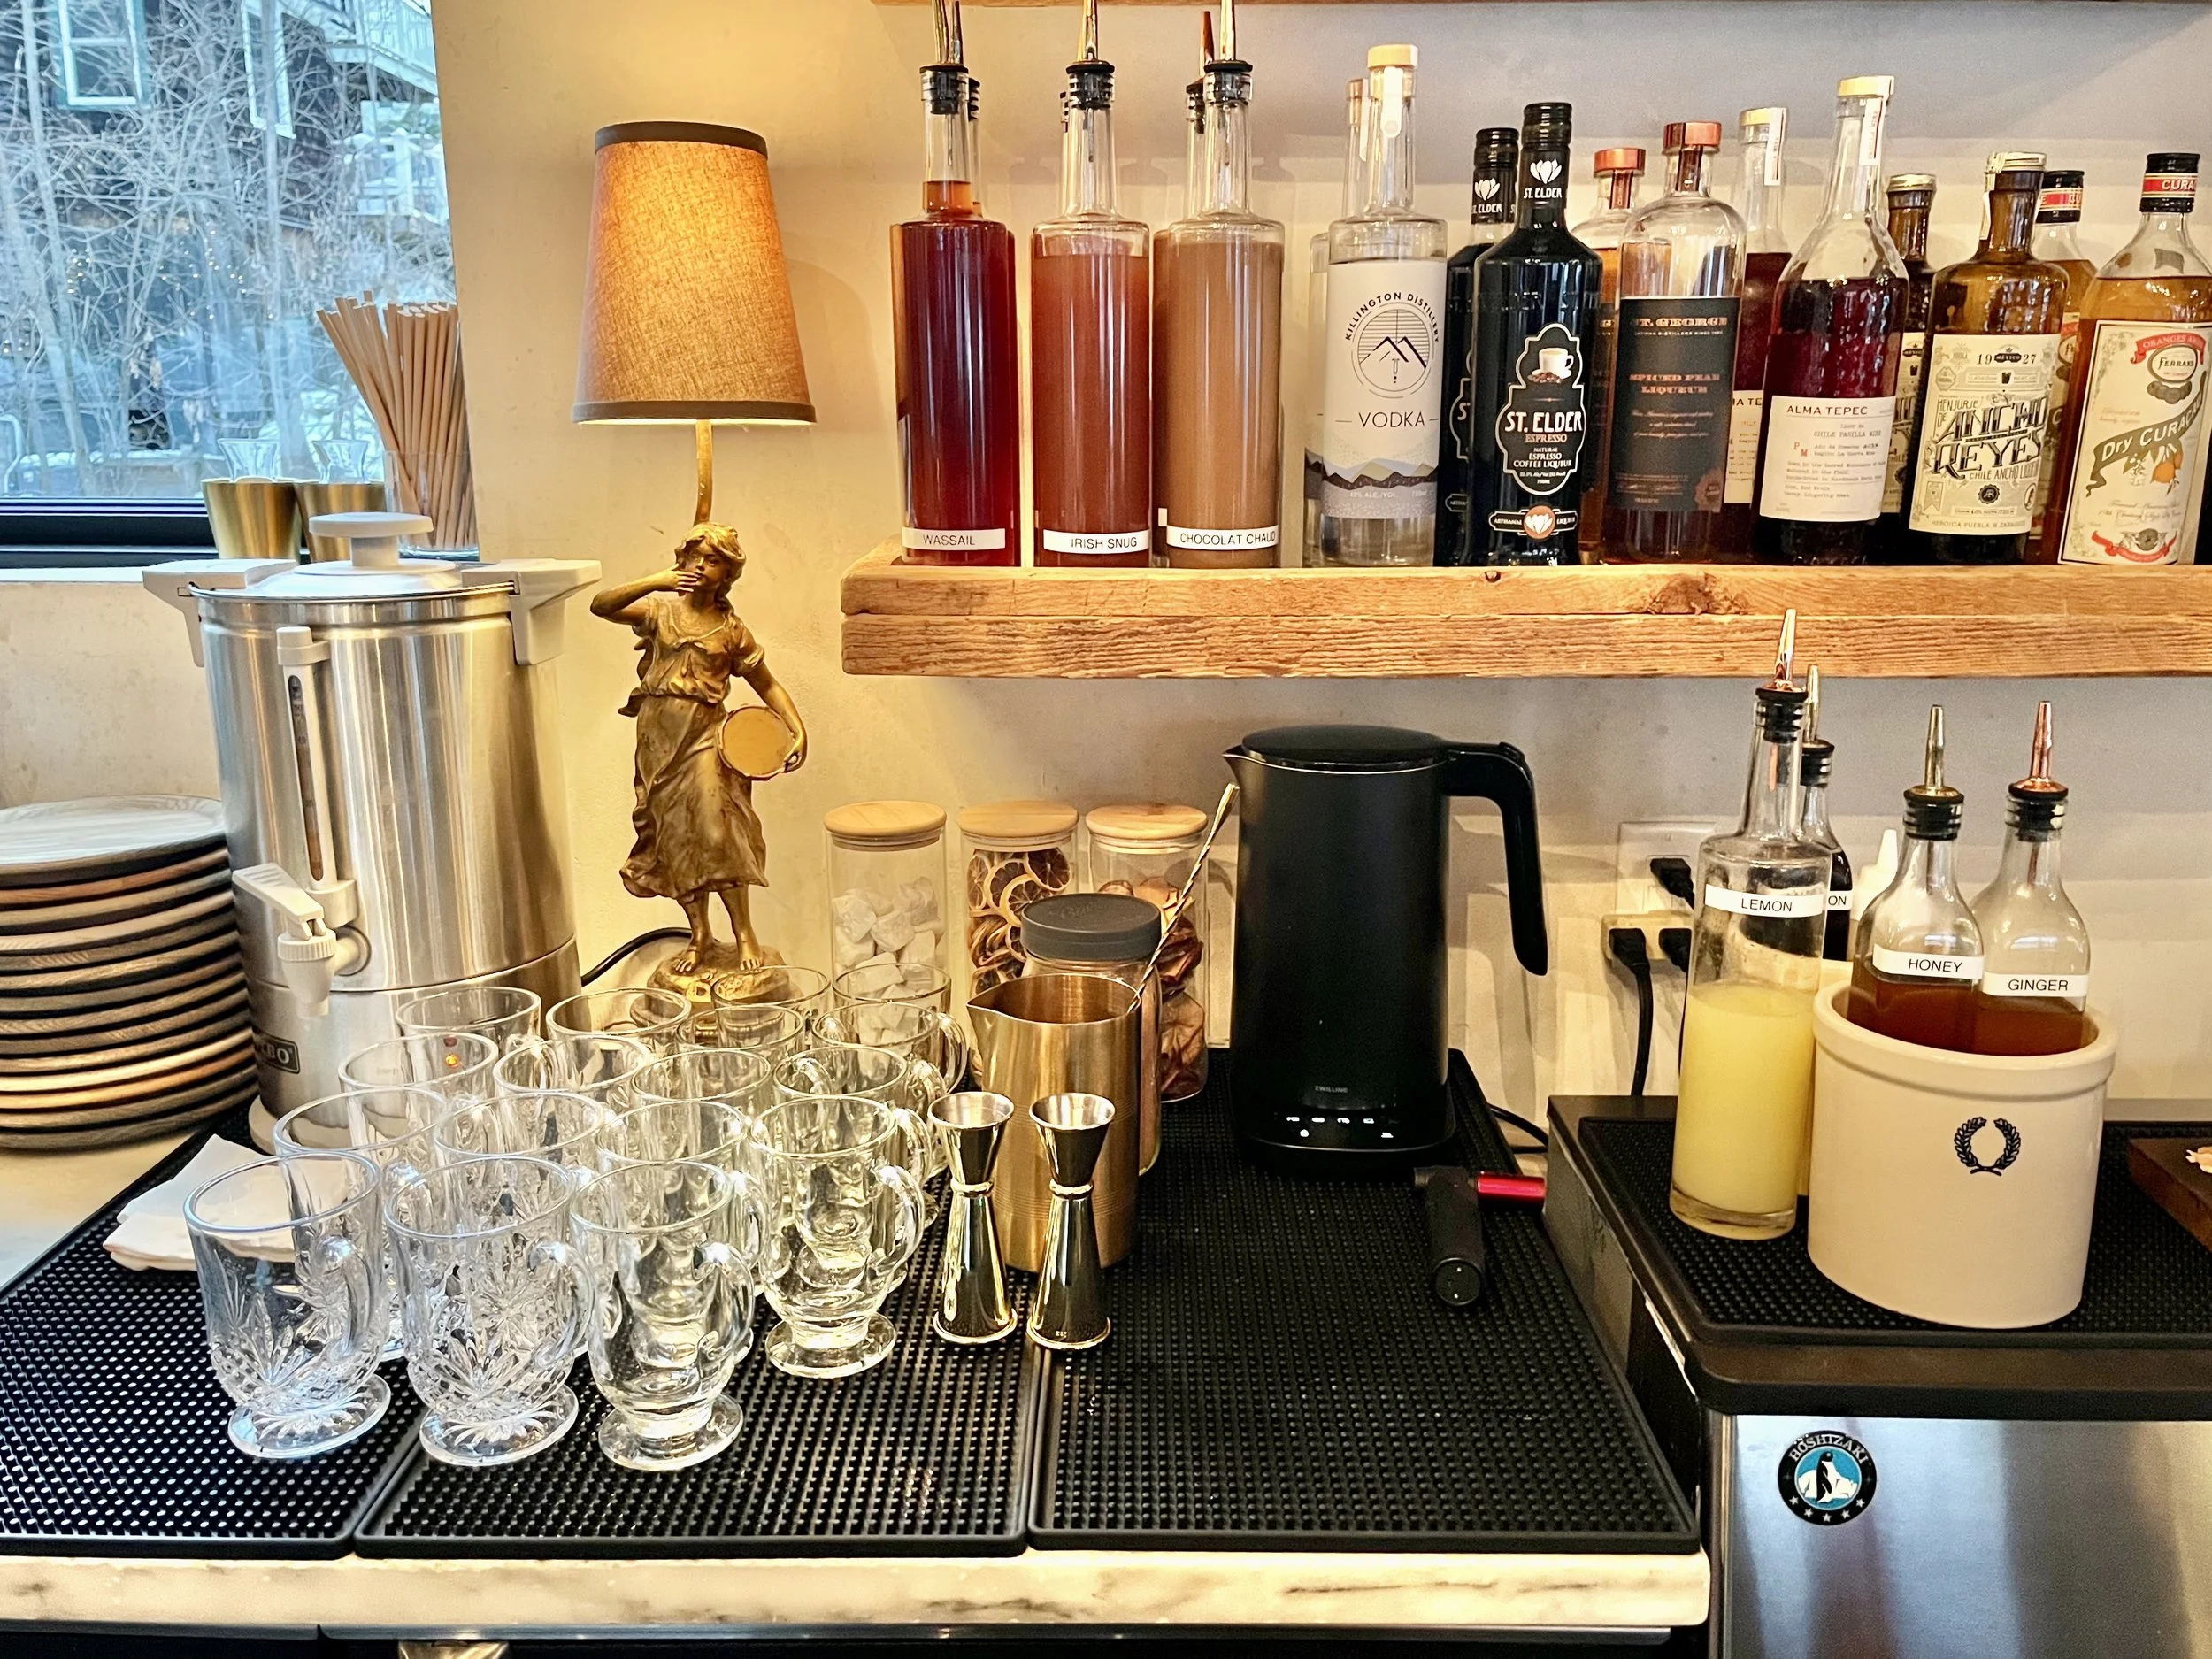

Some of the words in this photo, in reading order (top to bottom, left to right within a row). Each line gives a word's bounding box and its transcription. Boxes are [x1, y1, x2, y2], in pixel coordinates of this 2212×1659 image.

[1524, 188, 1533, 199] ST.
[1534, 187, 1563, 198] ELDER
[1478, 204, 1502, 213] ELDER
[1345, 292, 1402, 341] KILLINGTON
[1407, 293, 1439, 342] DISTILLERY
[1977, 354, 1992, 365] 19
[2022, 353, 2037, 365] 27
[1358, 411, 1425, 428] VODKA
[1504, 411, 1529, 433] ST.
[1532, 411, 1583, 433] ELDER
[1525, 434, 1568, 443] ESPRESSO
[1932, 426, 2044, 480] REYES
[2101, 436, 2133, 462] Dry
[1513, 459, 1542, 468] COFFEE
[1543, 459, 1572, 469] LIQUEUR
[1970, 470, 1992, 479] CHILE
[923, 534, 976, 546] WASSAIL
[1071, 538, 1103, 549] IRISH
[1107, 536, 1138, 549] SNUG
[1179, 533, 1243, 546] CHOCOLAT
[1740, 897, 1793, 912] LEMON
[1828, 895, 1847, 906] ON
[1908, 958, 1963, 972] HONEY
[2008, 979, 2069, 992] GINGER
[1788, 1433, 1869, 1464] HOSHIZAKI
